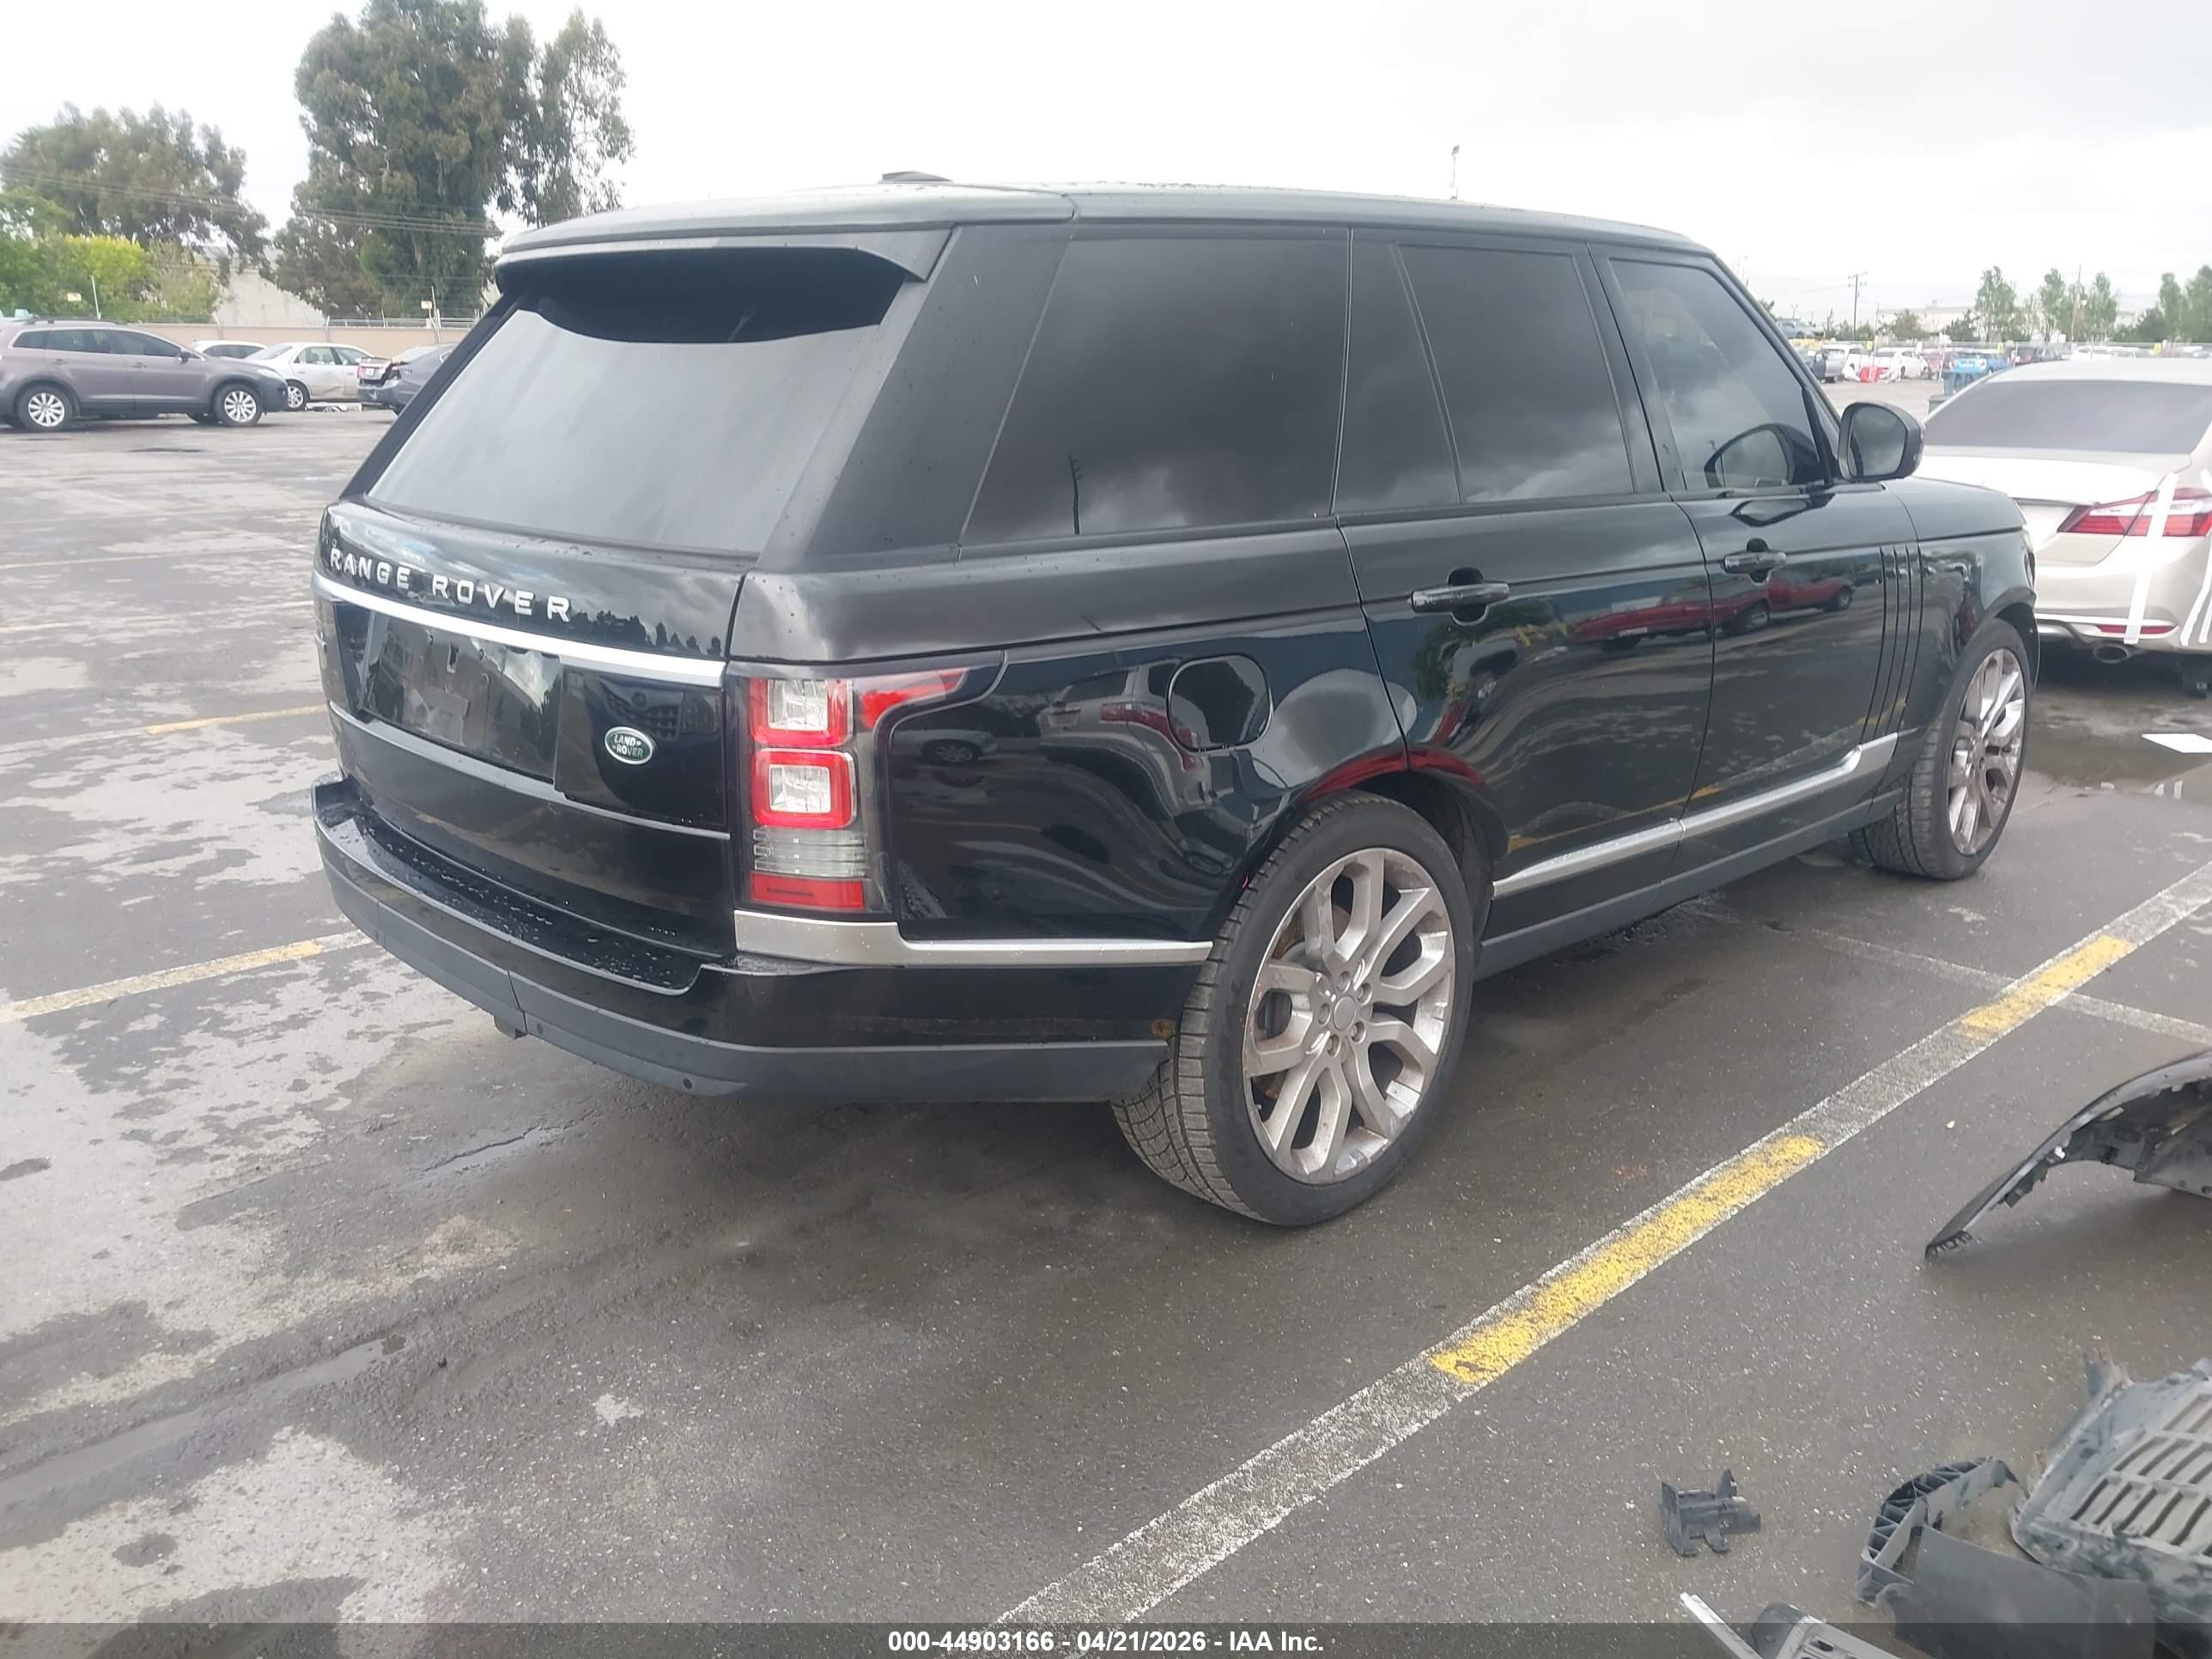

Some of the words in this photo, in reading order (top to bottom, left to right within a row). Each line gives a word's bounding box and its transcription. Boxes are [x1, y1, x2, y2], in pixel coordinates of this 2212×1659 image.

[330, 547, 411, 590] RANGE
[432, 574, 571, 623] ROVER
[614, 733, 636, 747] LAND
[617, 744, 644, 757] ROVER
